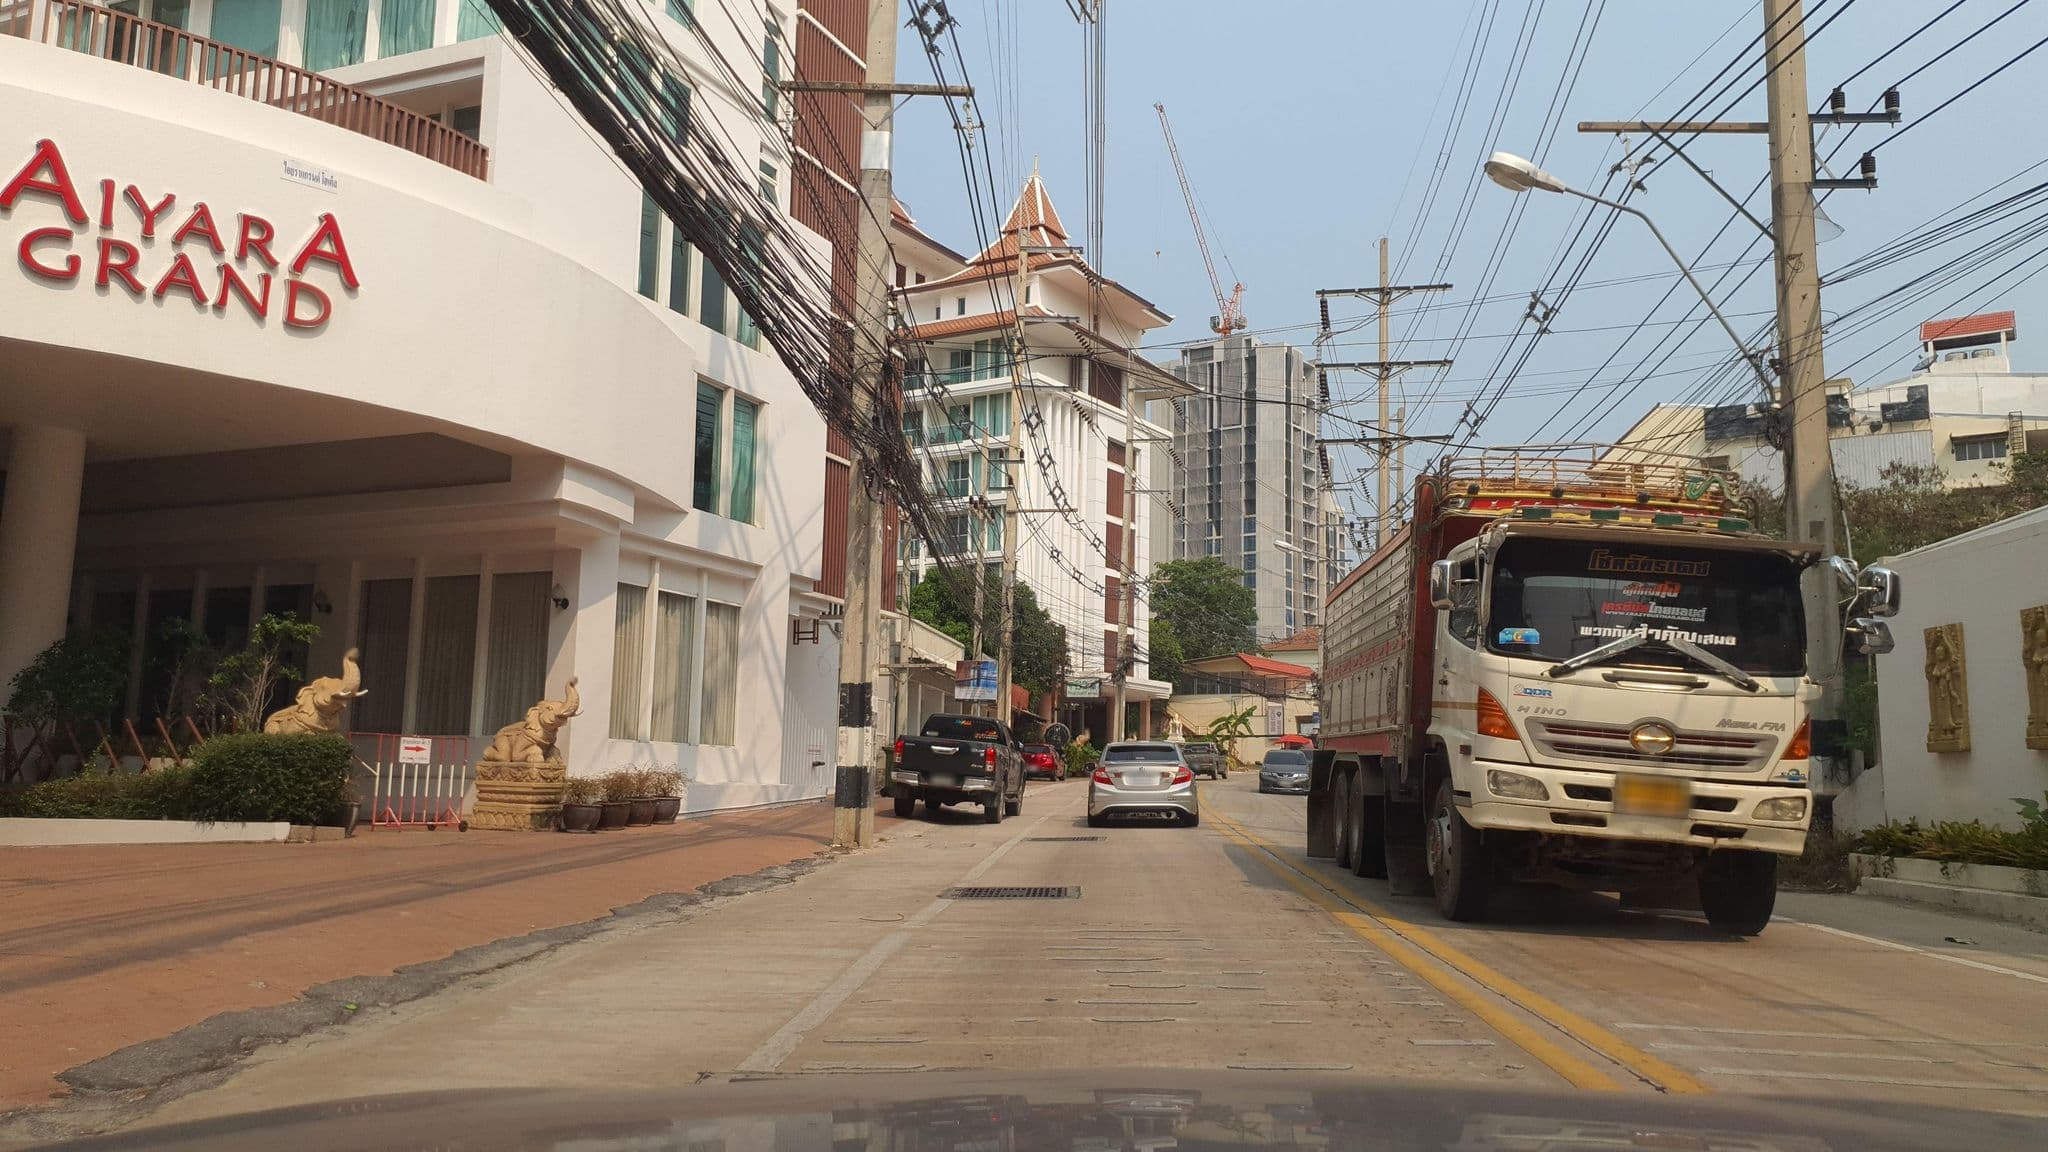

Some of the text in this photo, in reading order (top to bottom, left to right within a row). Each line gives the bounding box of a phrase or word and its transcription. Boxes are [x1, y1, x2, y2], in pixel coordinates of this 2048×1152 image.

[0, 138, 360, 288] AIYARA
[18, 227, 332, 328] GRAND
[1517, 705, 1567, 717] HINO
